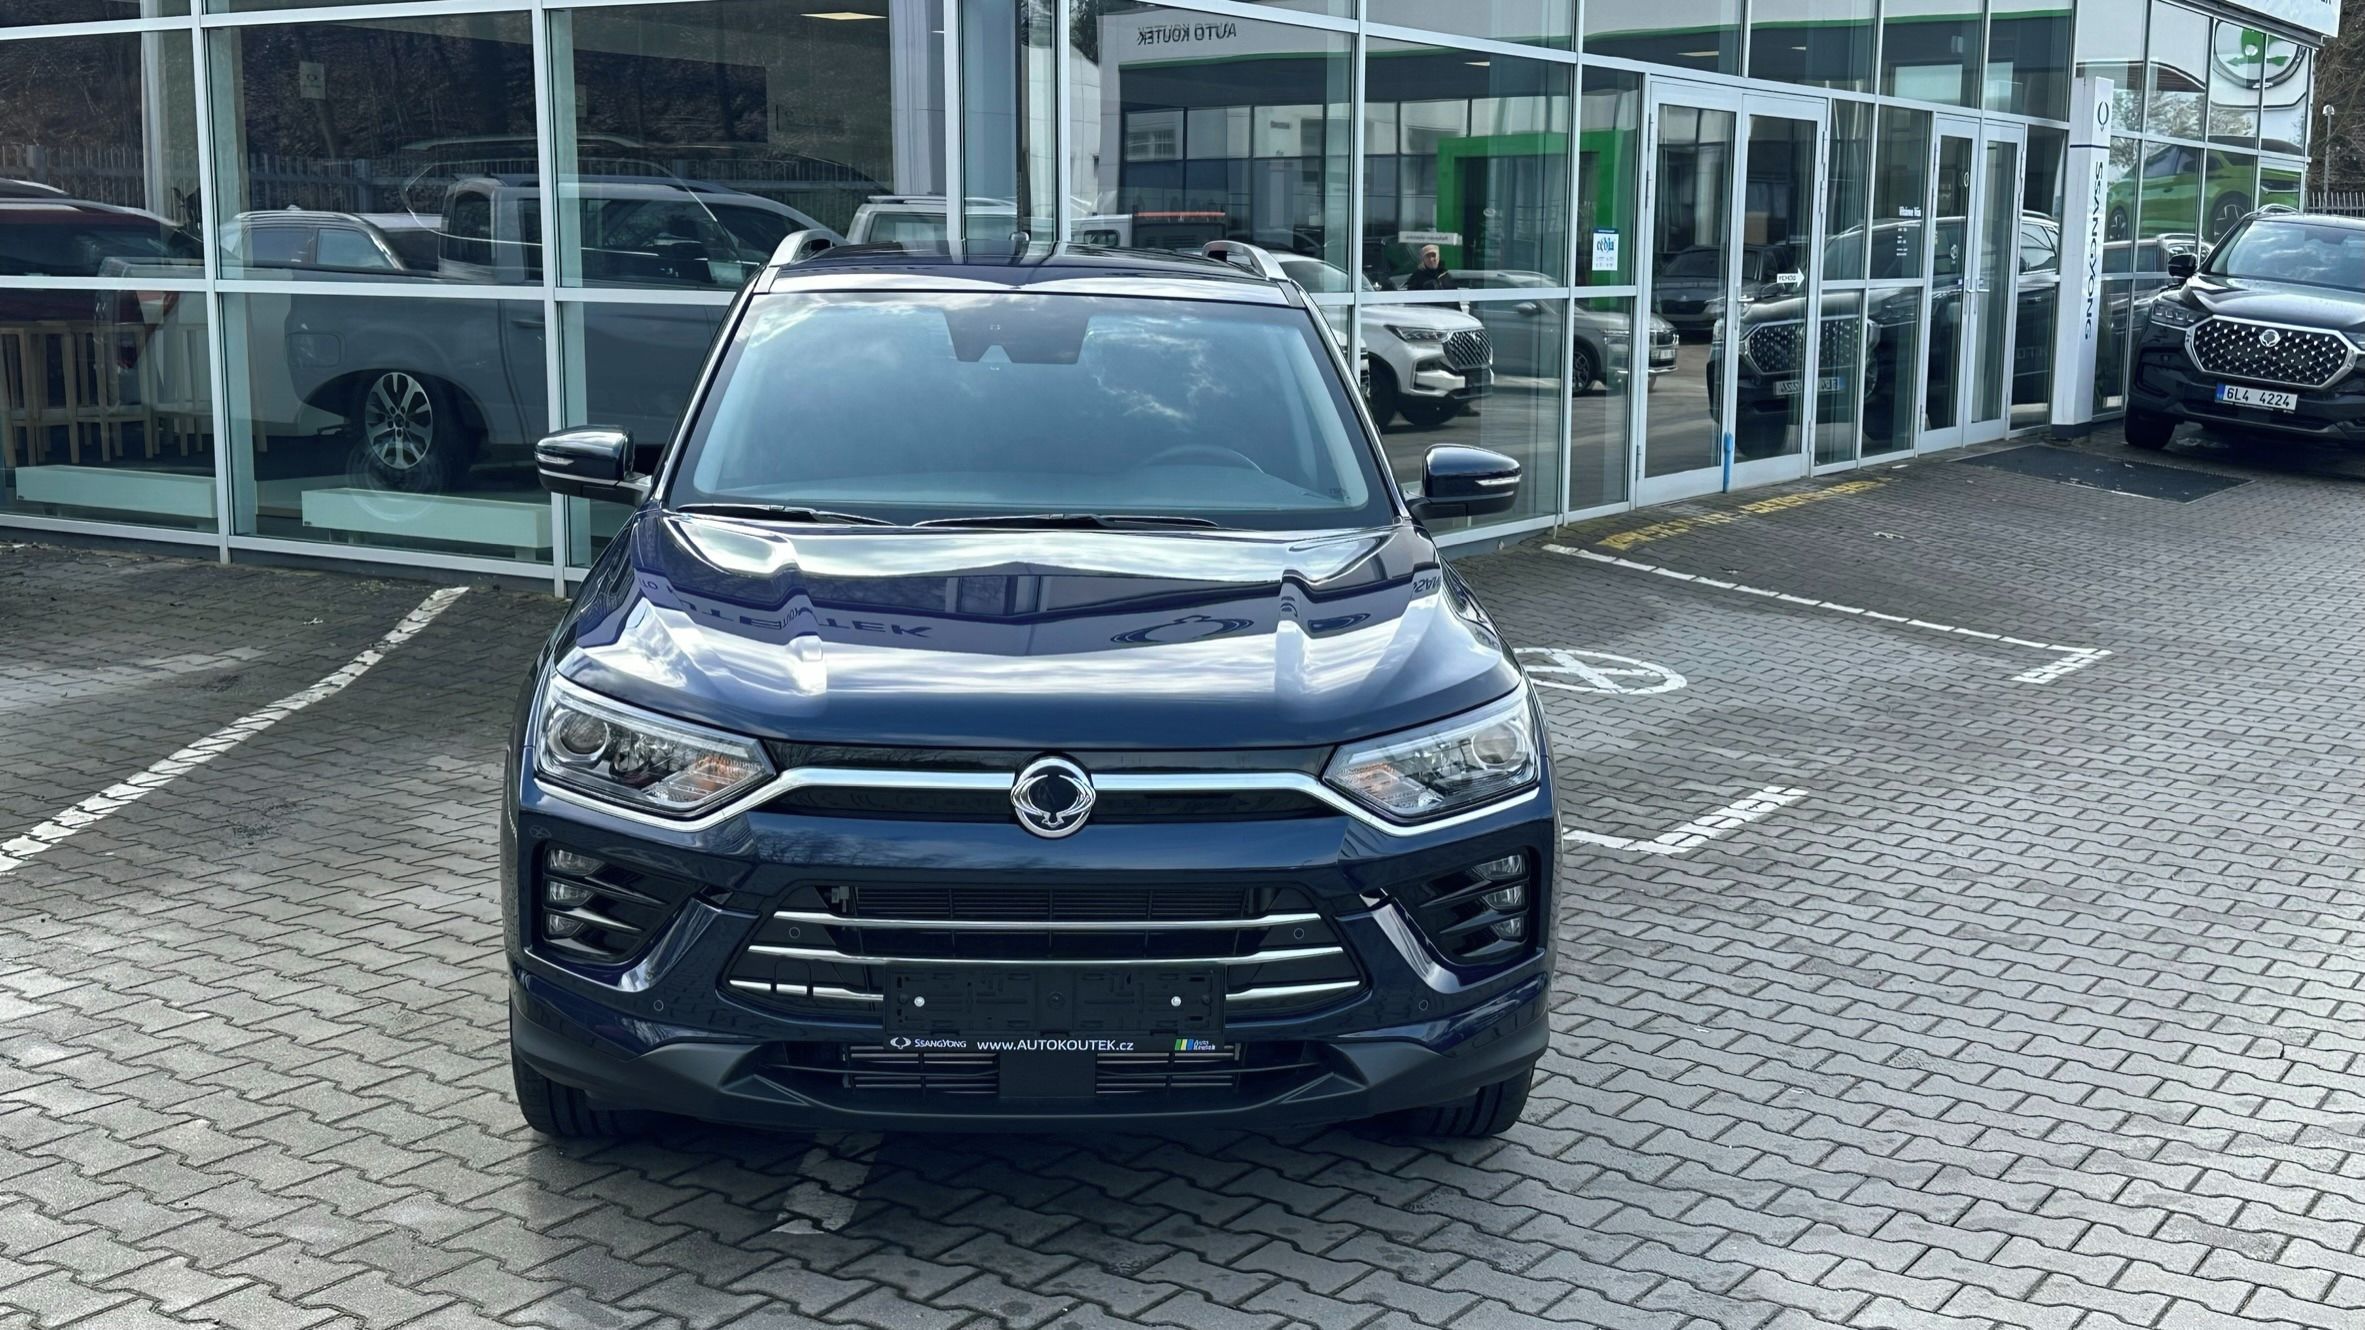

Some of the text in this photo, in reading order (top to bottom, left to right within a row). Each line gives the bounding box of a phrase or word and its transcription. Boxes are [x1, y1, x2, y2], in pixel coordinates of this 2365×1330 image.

[2085, 161, 2103, 340] SSANGYONG
[2226, 387, 2290, 407] 6L4 4224
[977, 1039, 1134, 1051] www.AUTOKOUTEK.cz
